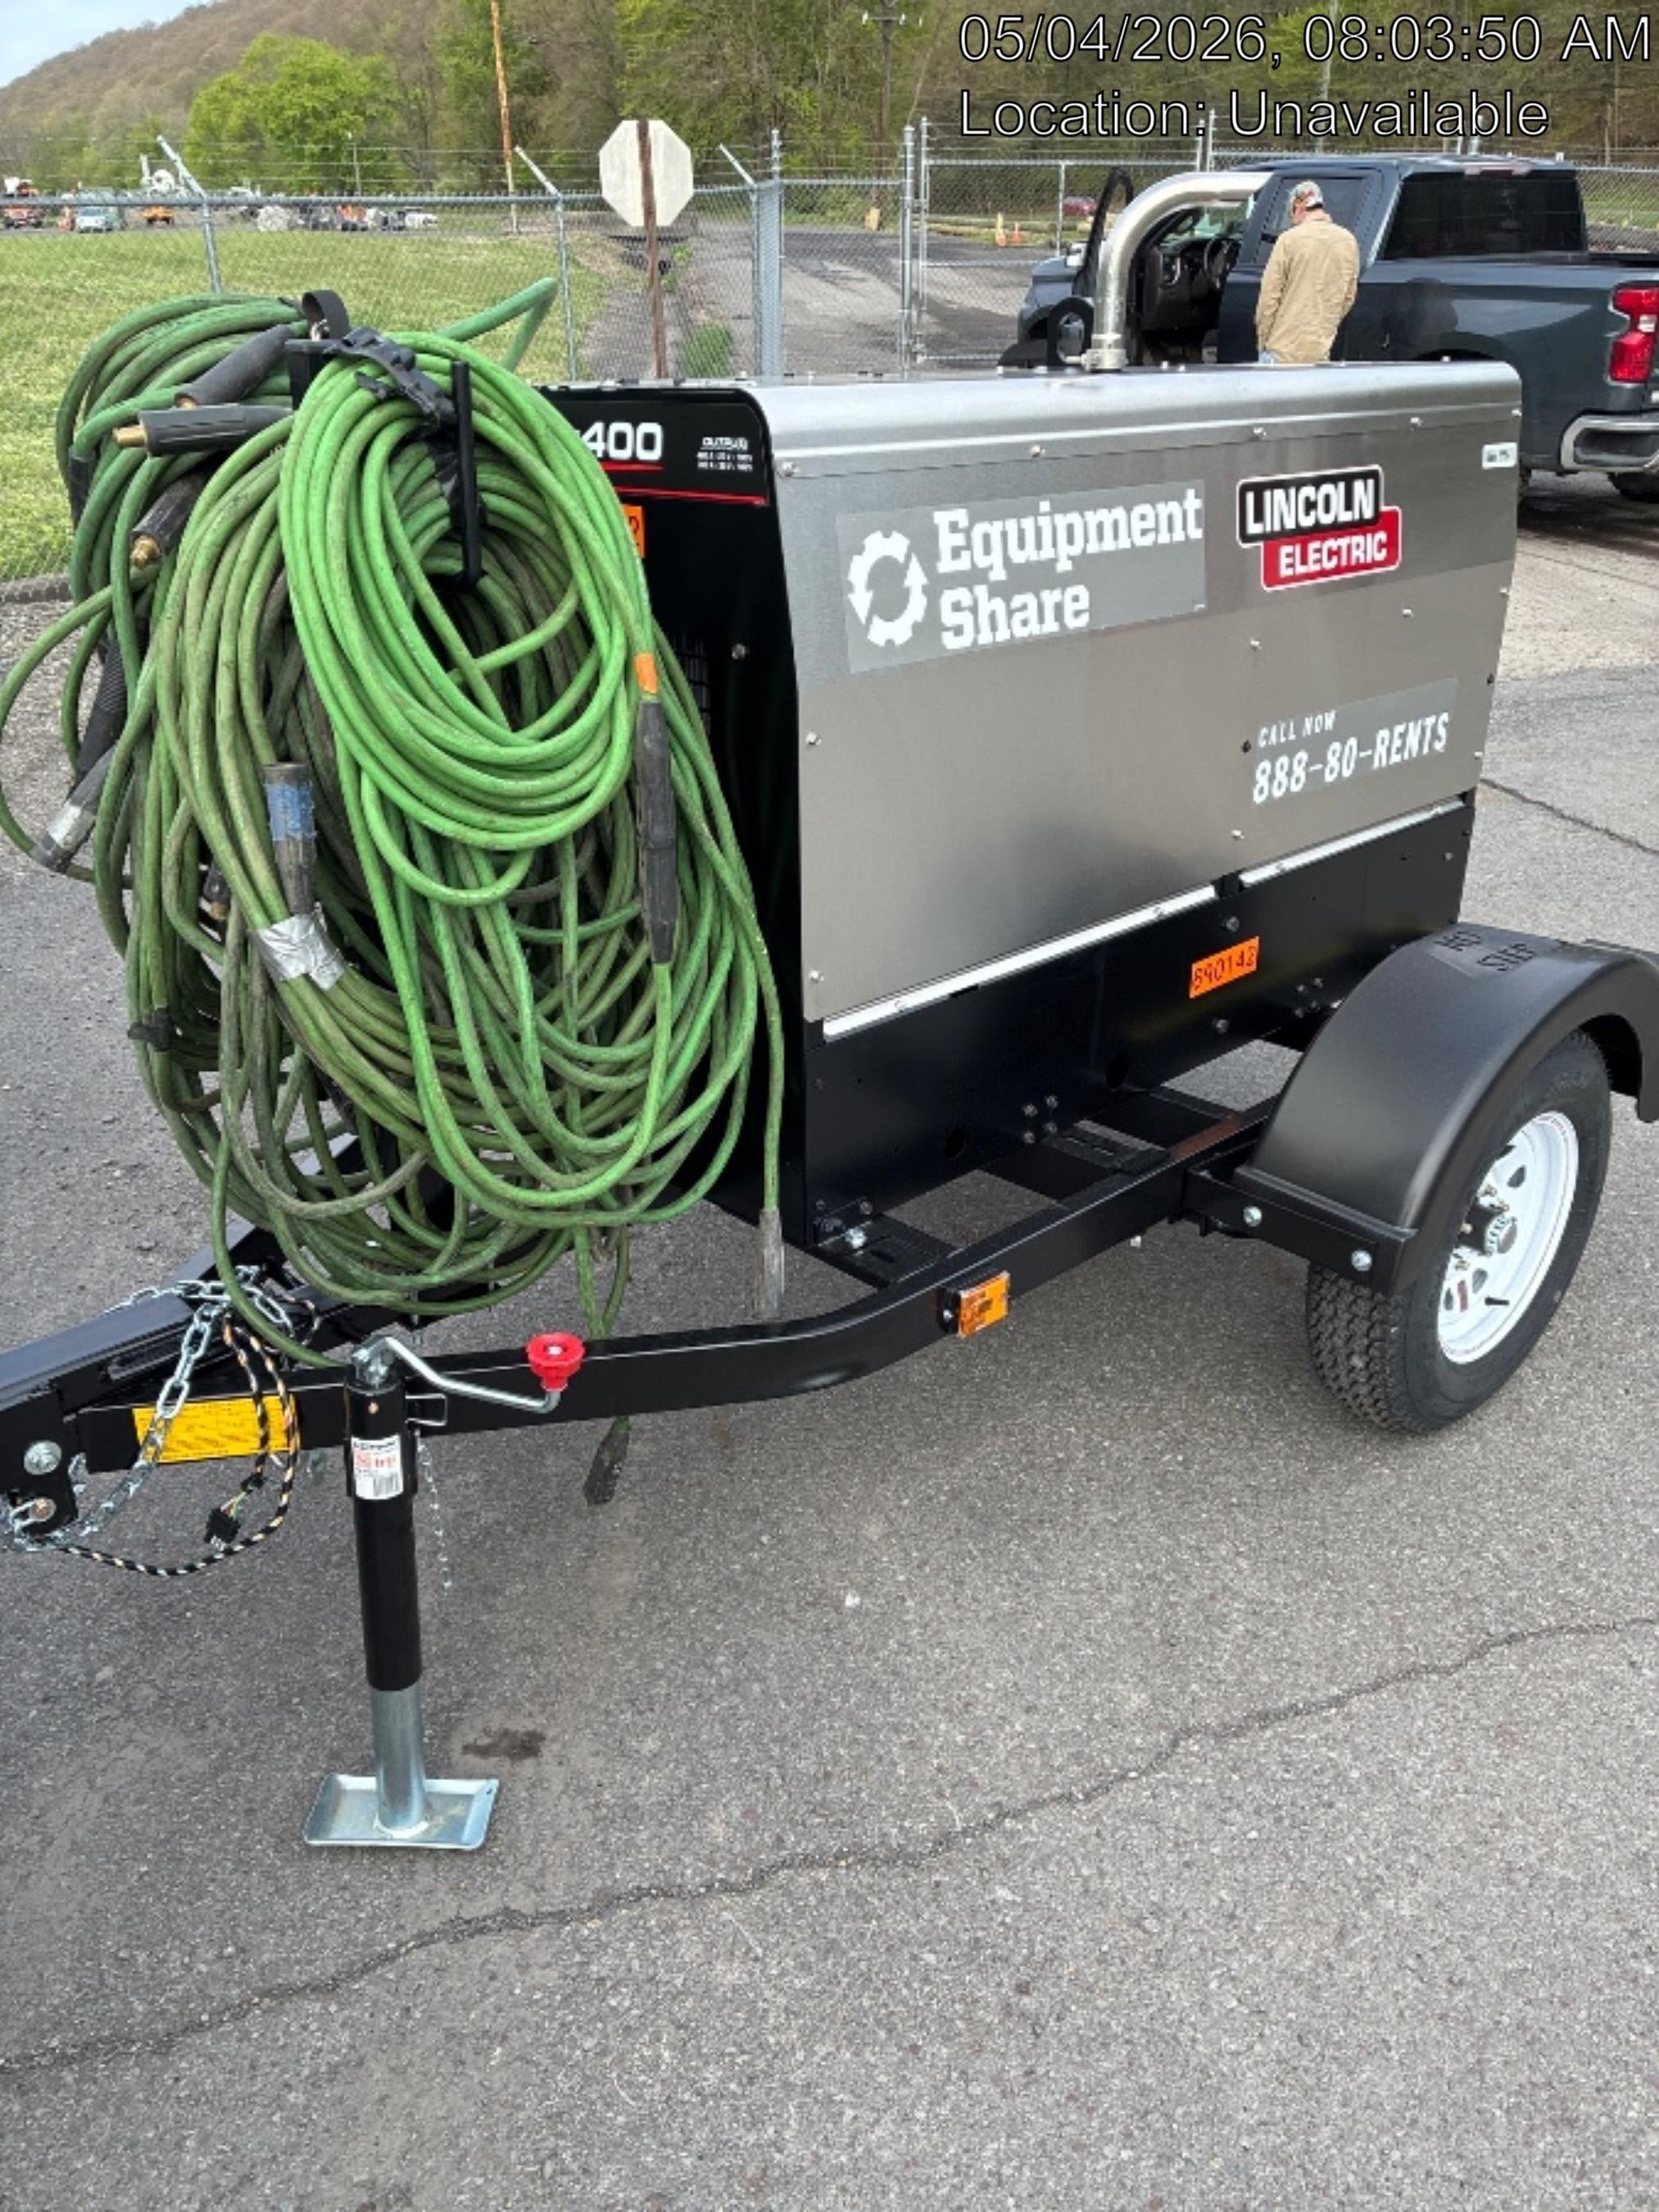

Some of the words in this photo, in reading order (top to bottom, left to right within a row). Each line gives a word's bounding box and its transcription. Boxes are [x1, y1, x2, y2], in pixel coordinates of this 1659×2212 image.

[932, 488, 1203, 582] Equipment
[1244, 478, 1376, 534] LINCOLN
[1279, 530, 1389, 578] ELECTRIC
[939, 584, 1090, 650] Share
[1253, 711, 1450, 805] 888-80-RENTS
[1258, 720, 1297, 748] CALL
[1302, 709, 1337, 737] NOW
